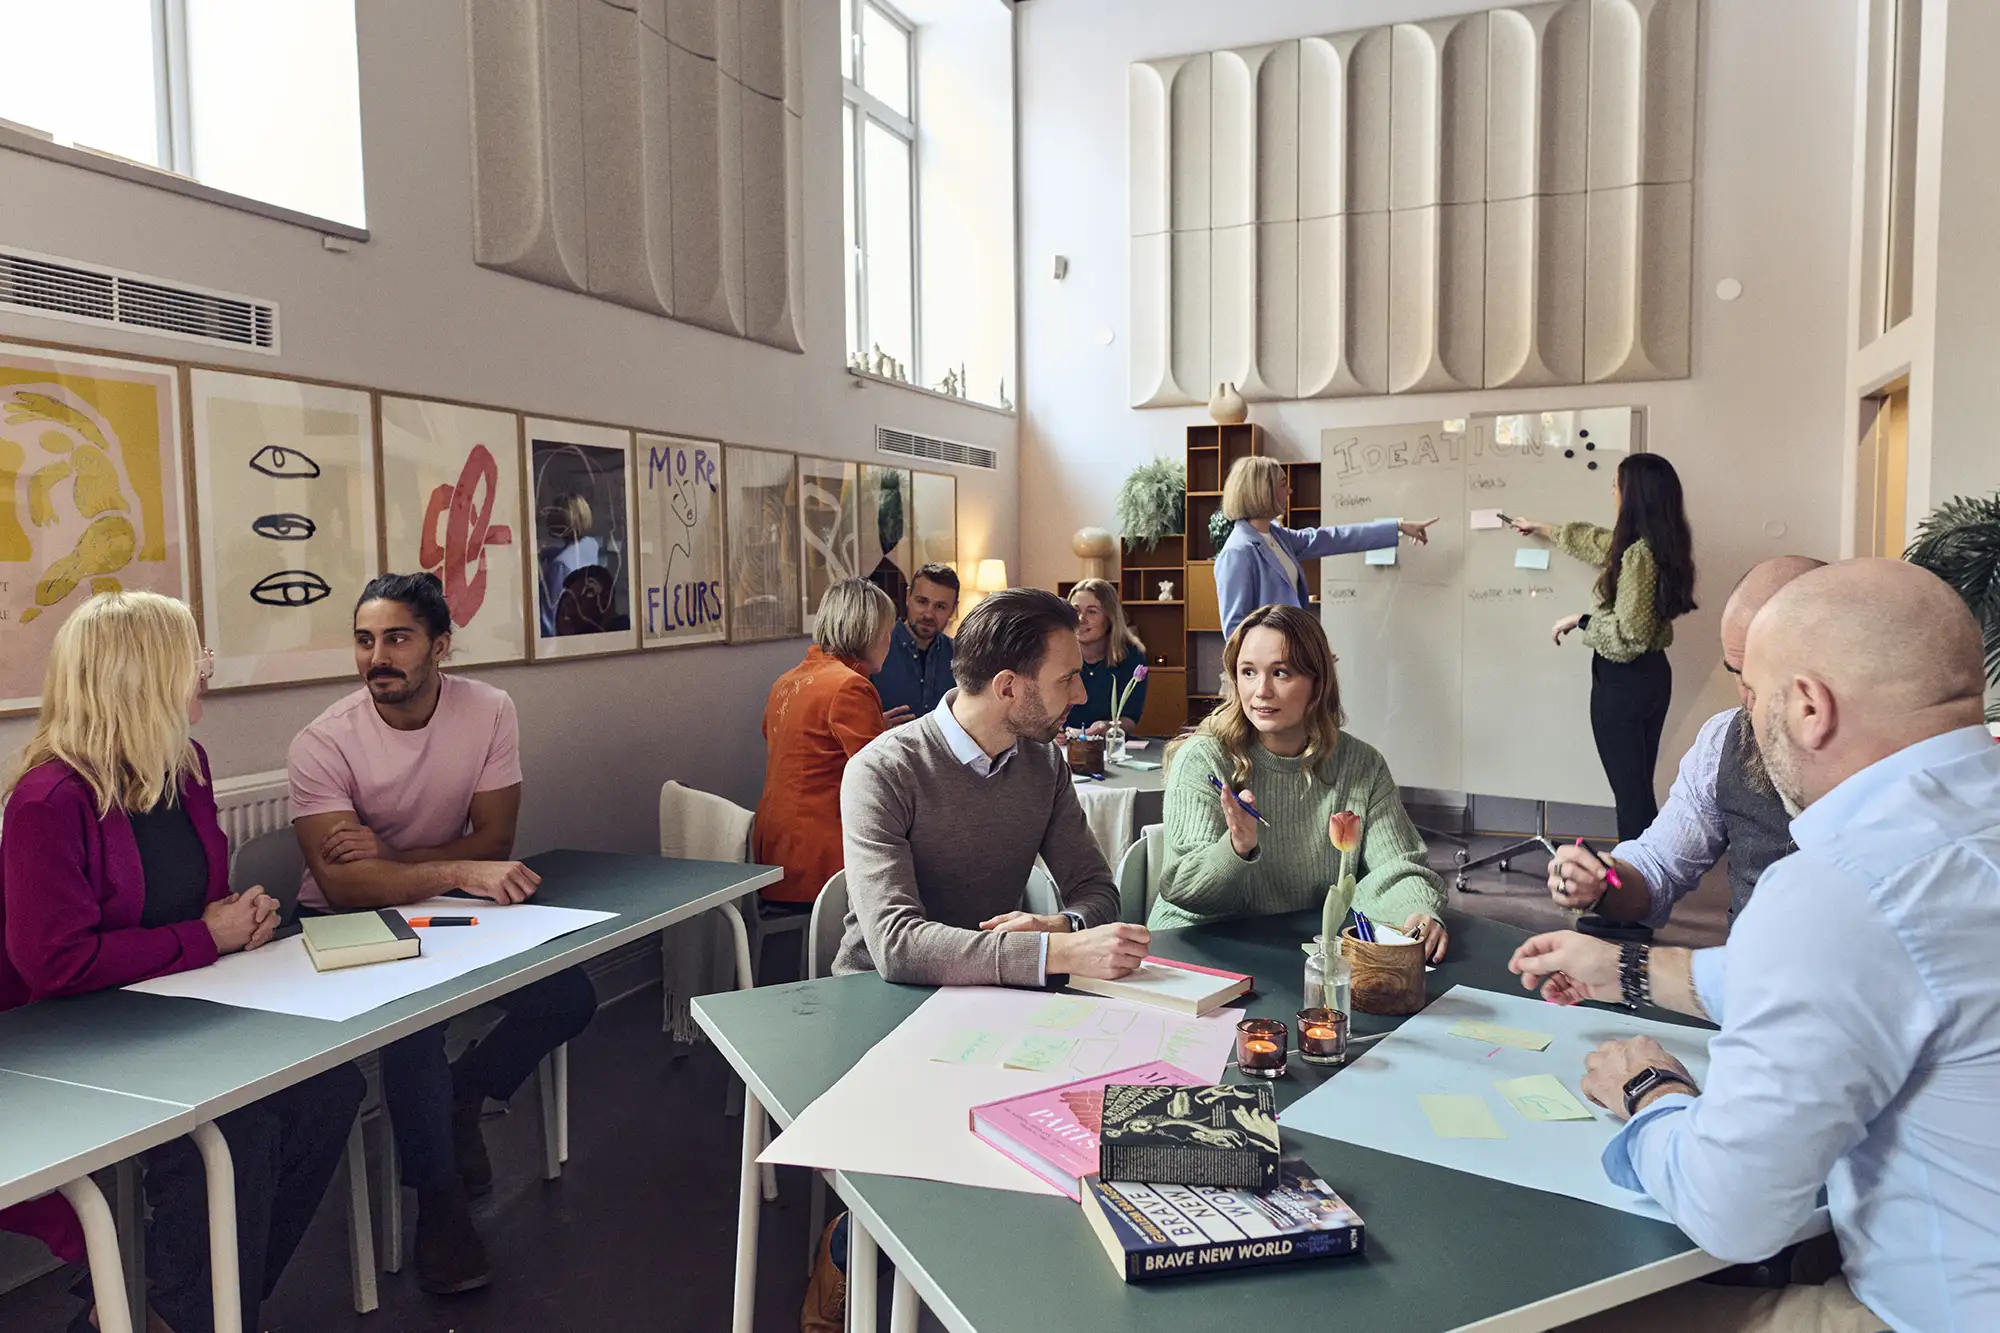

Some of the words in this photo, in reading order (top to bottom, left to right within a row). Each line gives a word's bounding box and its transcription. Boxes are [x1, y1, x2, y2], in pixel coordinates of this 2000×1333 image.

[1333, 425, 1546, 480] IDEATION
[648, 581, 721, 633] FLEURS
[1129, 1192, 1194, 1236] BRAVE
[1164, 1191, 1216, 1218] NEW
[1145, 1251, 1194, 1271] BRAVE
[1199, 1246, 1234, 1265] NEW
[1238, 1240, 1293, 1260] WORLD
